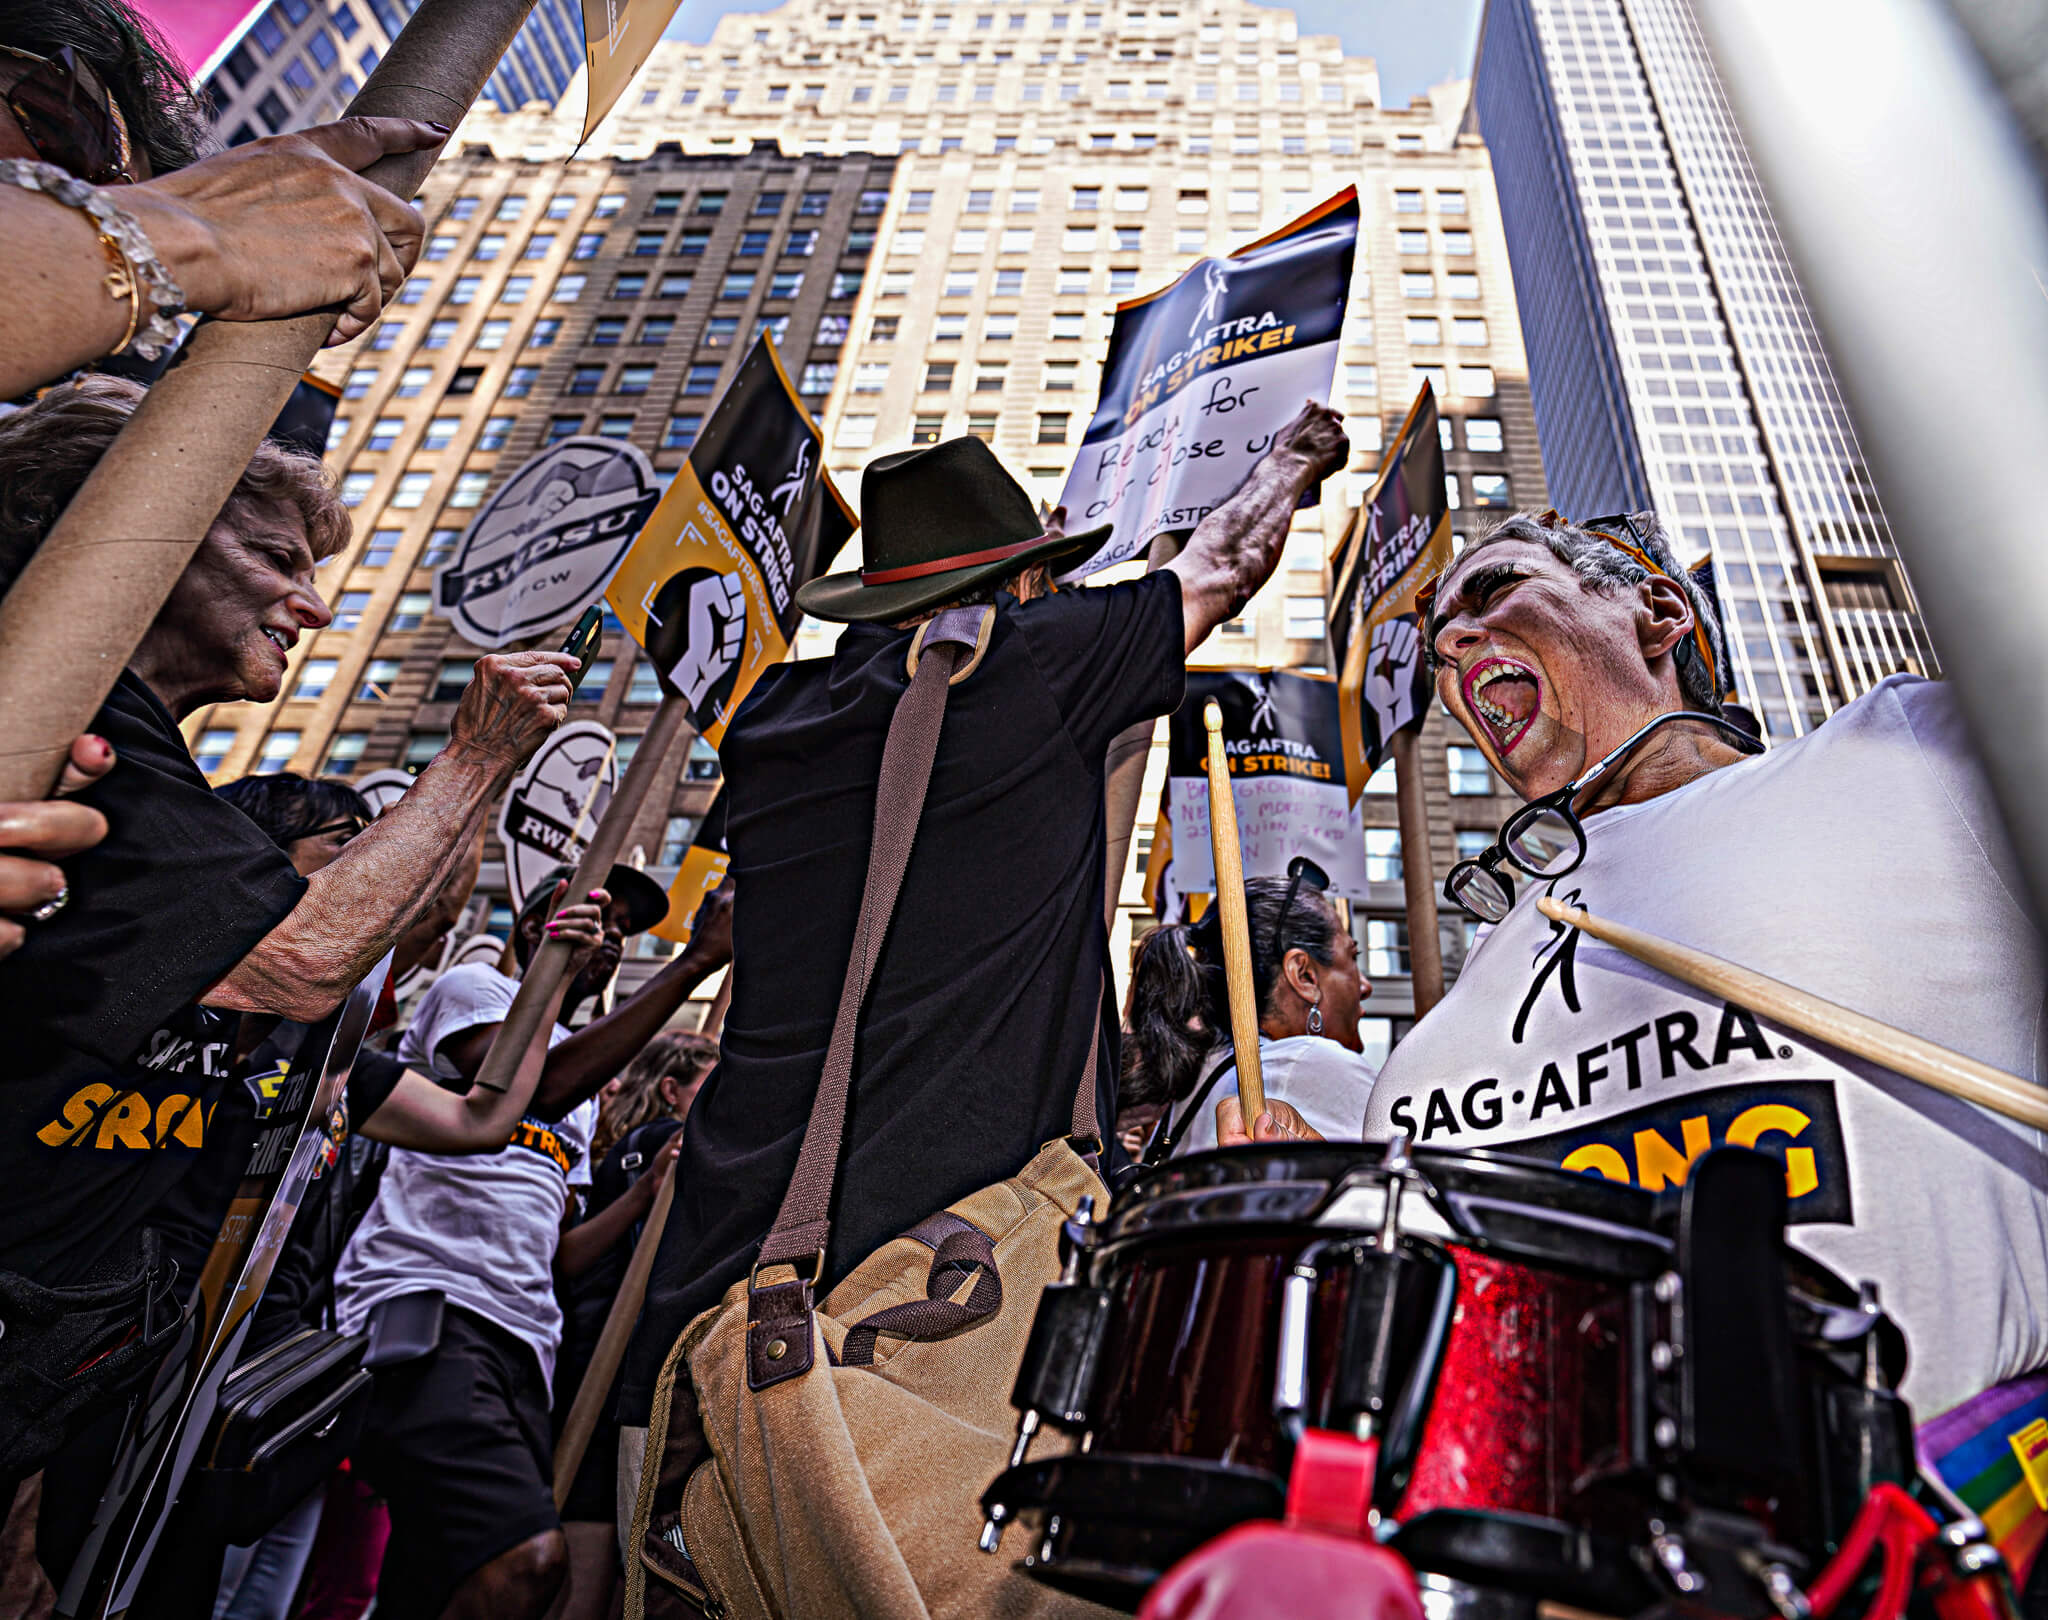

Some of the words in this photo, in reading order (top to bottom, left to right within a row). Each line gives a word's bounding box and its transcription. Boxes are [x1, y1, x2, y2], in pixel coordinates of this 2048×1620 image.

[1123, 382, 1161, 425] ON
[1165, 325, 1296, 395] STRIKE!
[1201, 376, 1260, 417] for
[1085, 479, 1136, 519] our
[1147, 438, 1226, 486] close
[1246, 431, 1280, 454] u
[464, 507, 638, 597] RWDSU
[711, 469, 746, 521] ON
[741, 515, 790, 615] STRIKE!
[1225, 738, 1322, 760] AG·AFTRA
[1243, 754, 1332, 780] STRIKE!
[1275, 837, 1303, 854] TV
